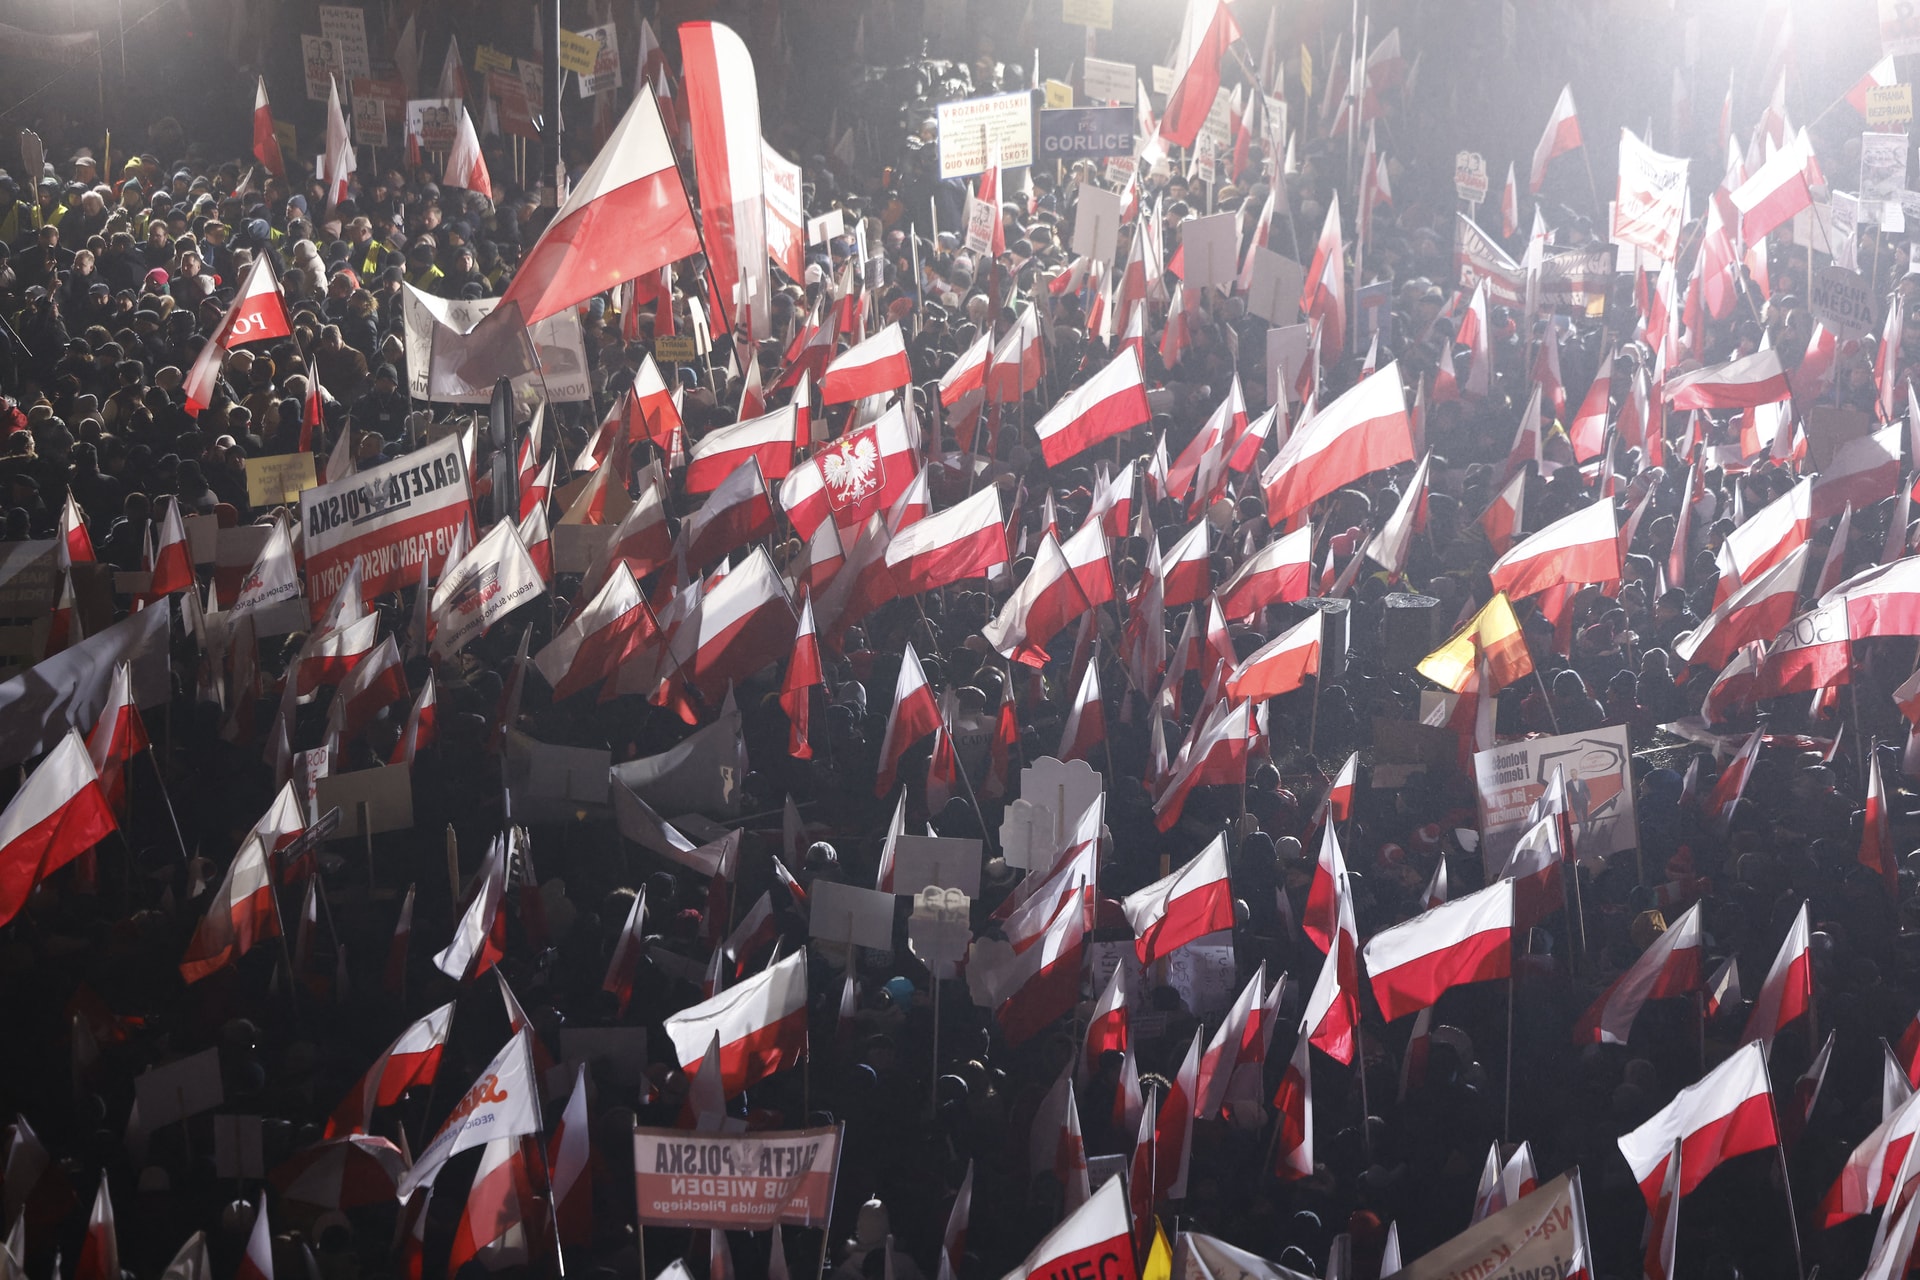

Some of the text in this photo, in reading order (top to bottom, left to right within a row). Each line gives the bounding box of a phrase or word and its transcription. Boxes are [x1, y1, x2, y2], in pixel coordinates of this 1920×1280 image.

[1873, 90, 1904, 102] TYRANIA
[952, 102, 991, 117] ROZBIÓR
[1868, 104, 1911, 117] BEZPRAWIA
[1045, 134, 1129, 152] GORLICE
[945, 160, 962, 171] QUO
[1822, 276, 1868, 304] WOLNE
[1813, 287, 1874, 325] MEDIA
